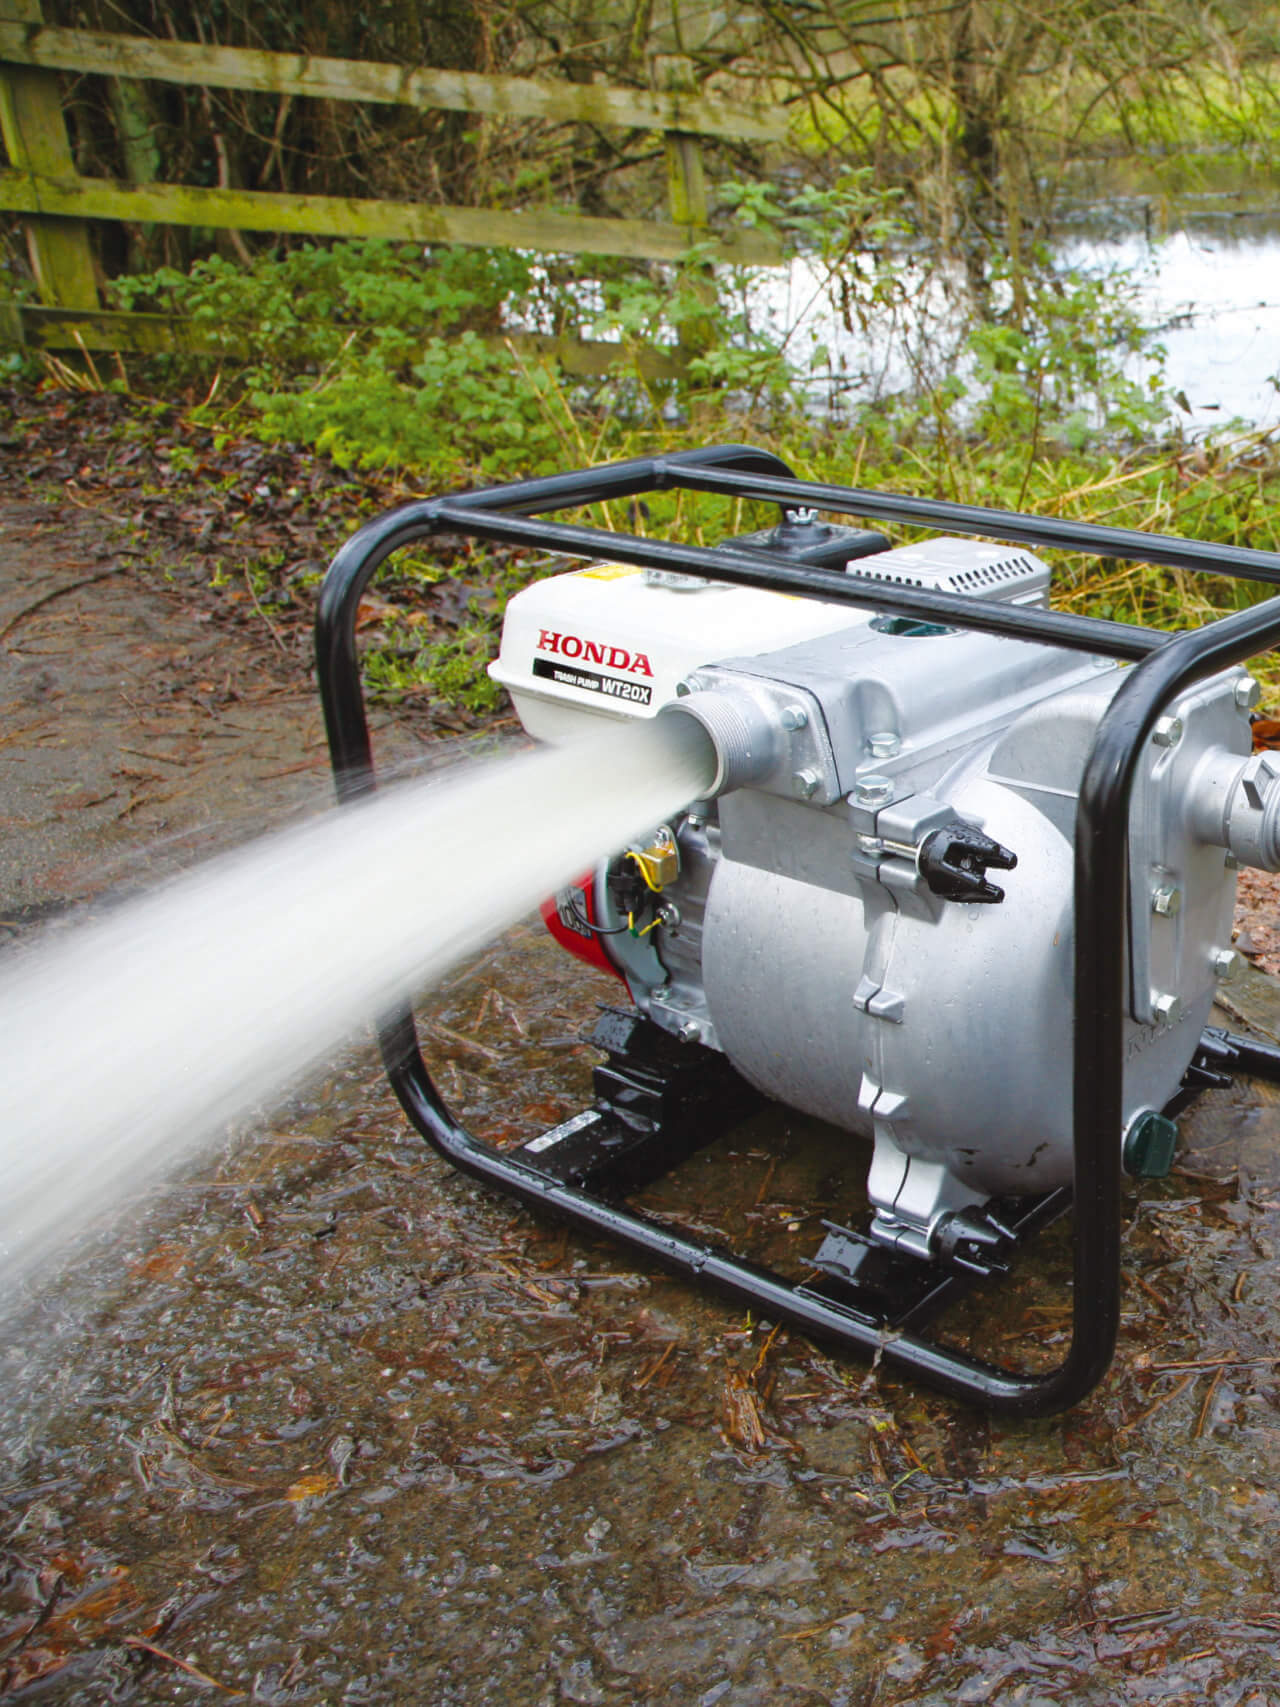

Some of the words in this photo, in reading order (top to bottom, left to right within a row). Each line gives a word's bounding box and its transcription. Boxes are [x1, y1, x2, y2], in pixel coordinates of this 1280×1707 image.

[536, 629, 654, 677] HONDA
[577, 676, 600, 690] PUMP
[601, 677, 650, 703] WT20X
